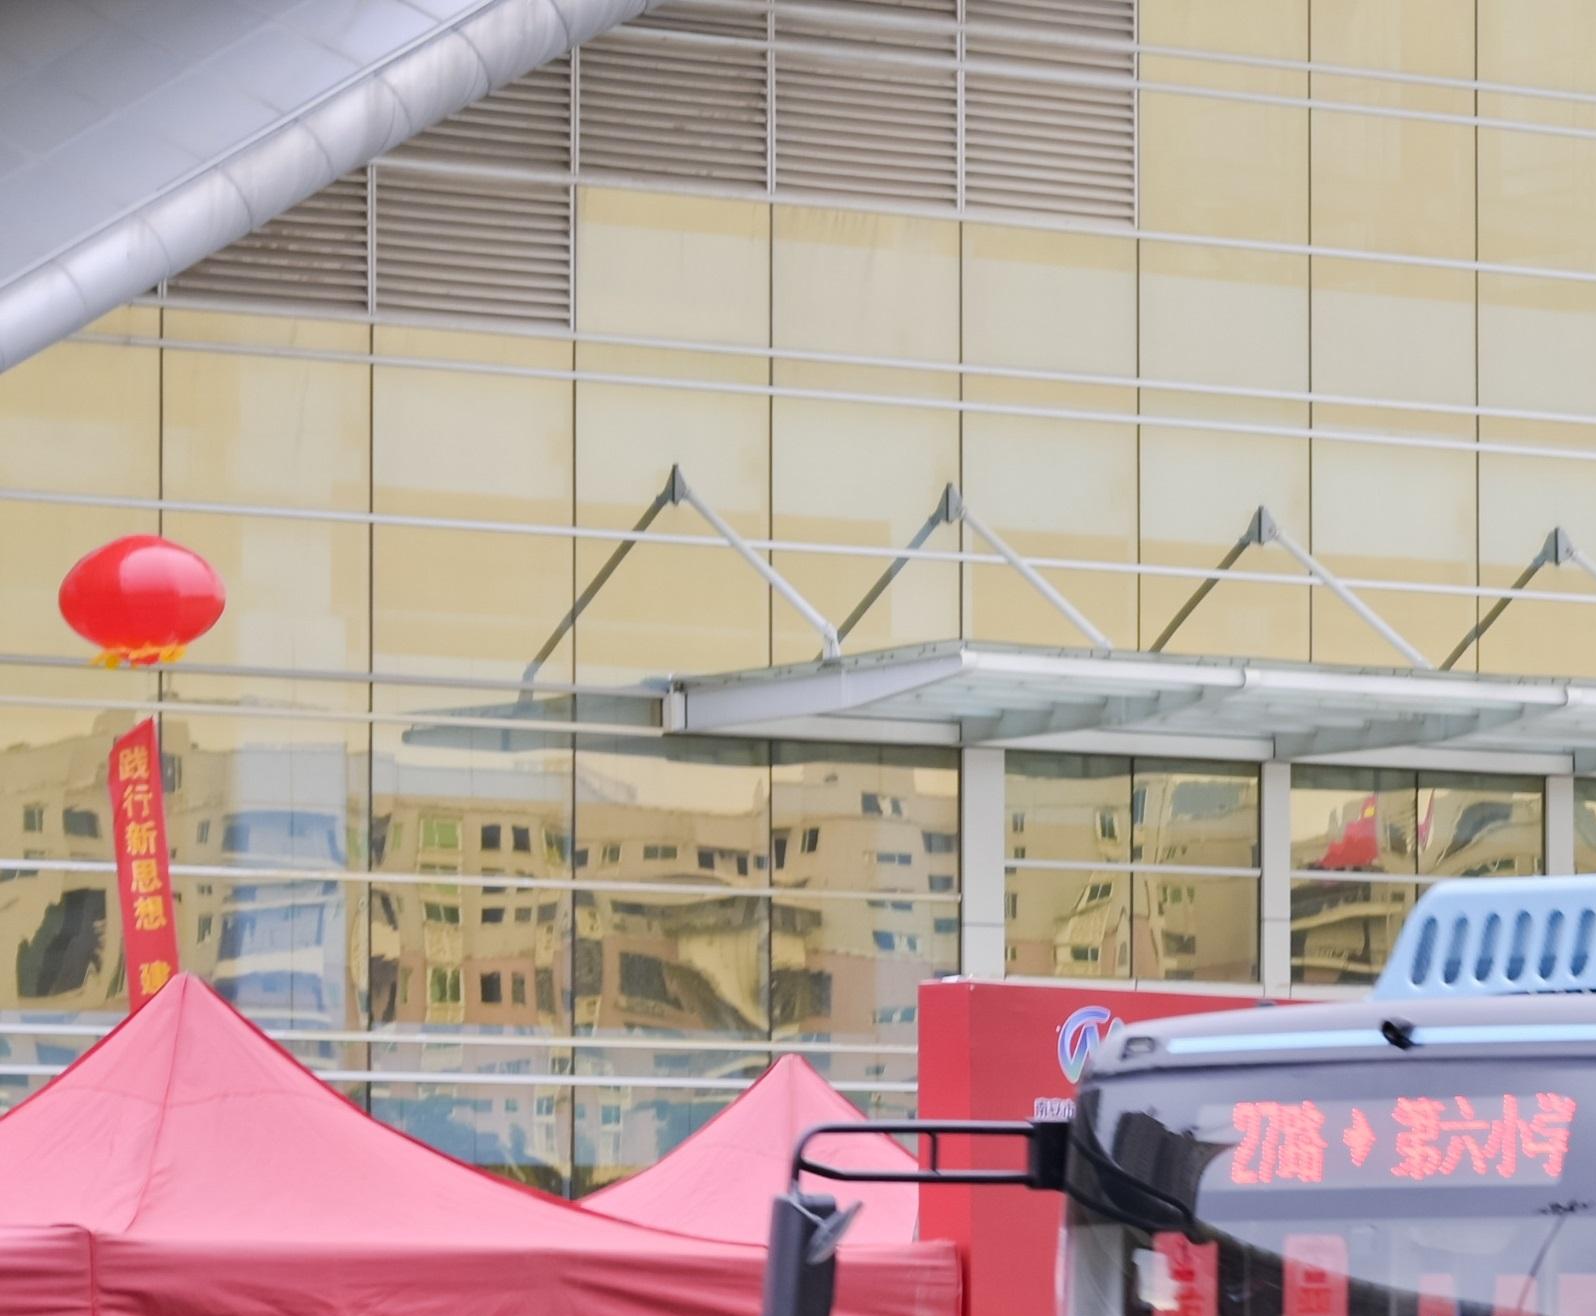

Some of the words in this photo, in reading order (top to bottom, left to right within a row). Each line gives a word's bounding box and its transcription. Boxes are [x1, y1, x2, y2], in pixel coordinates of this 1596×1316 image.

[118, 746, 166, 931] 践行新思想
[1232, 1101, 1327, 1183] 27路
[1392, 1093, 1576, 1181] 第六小学
